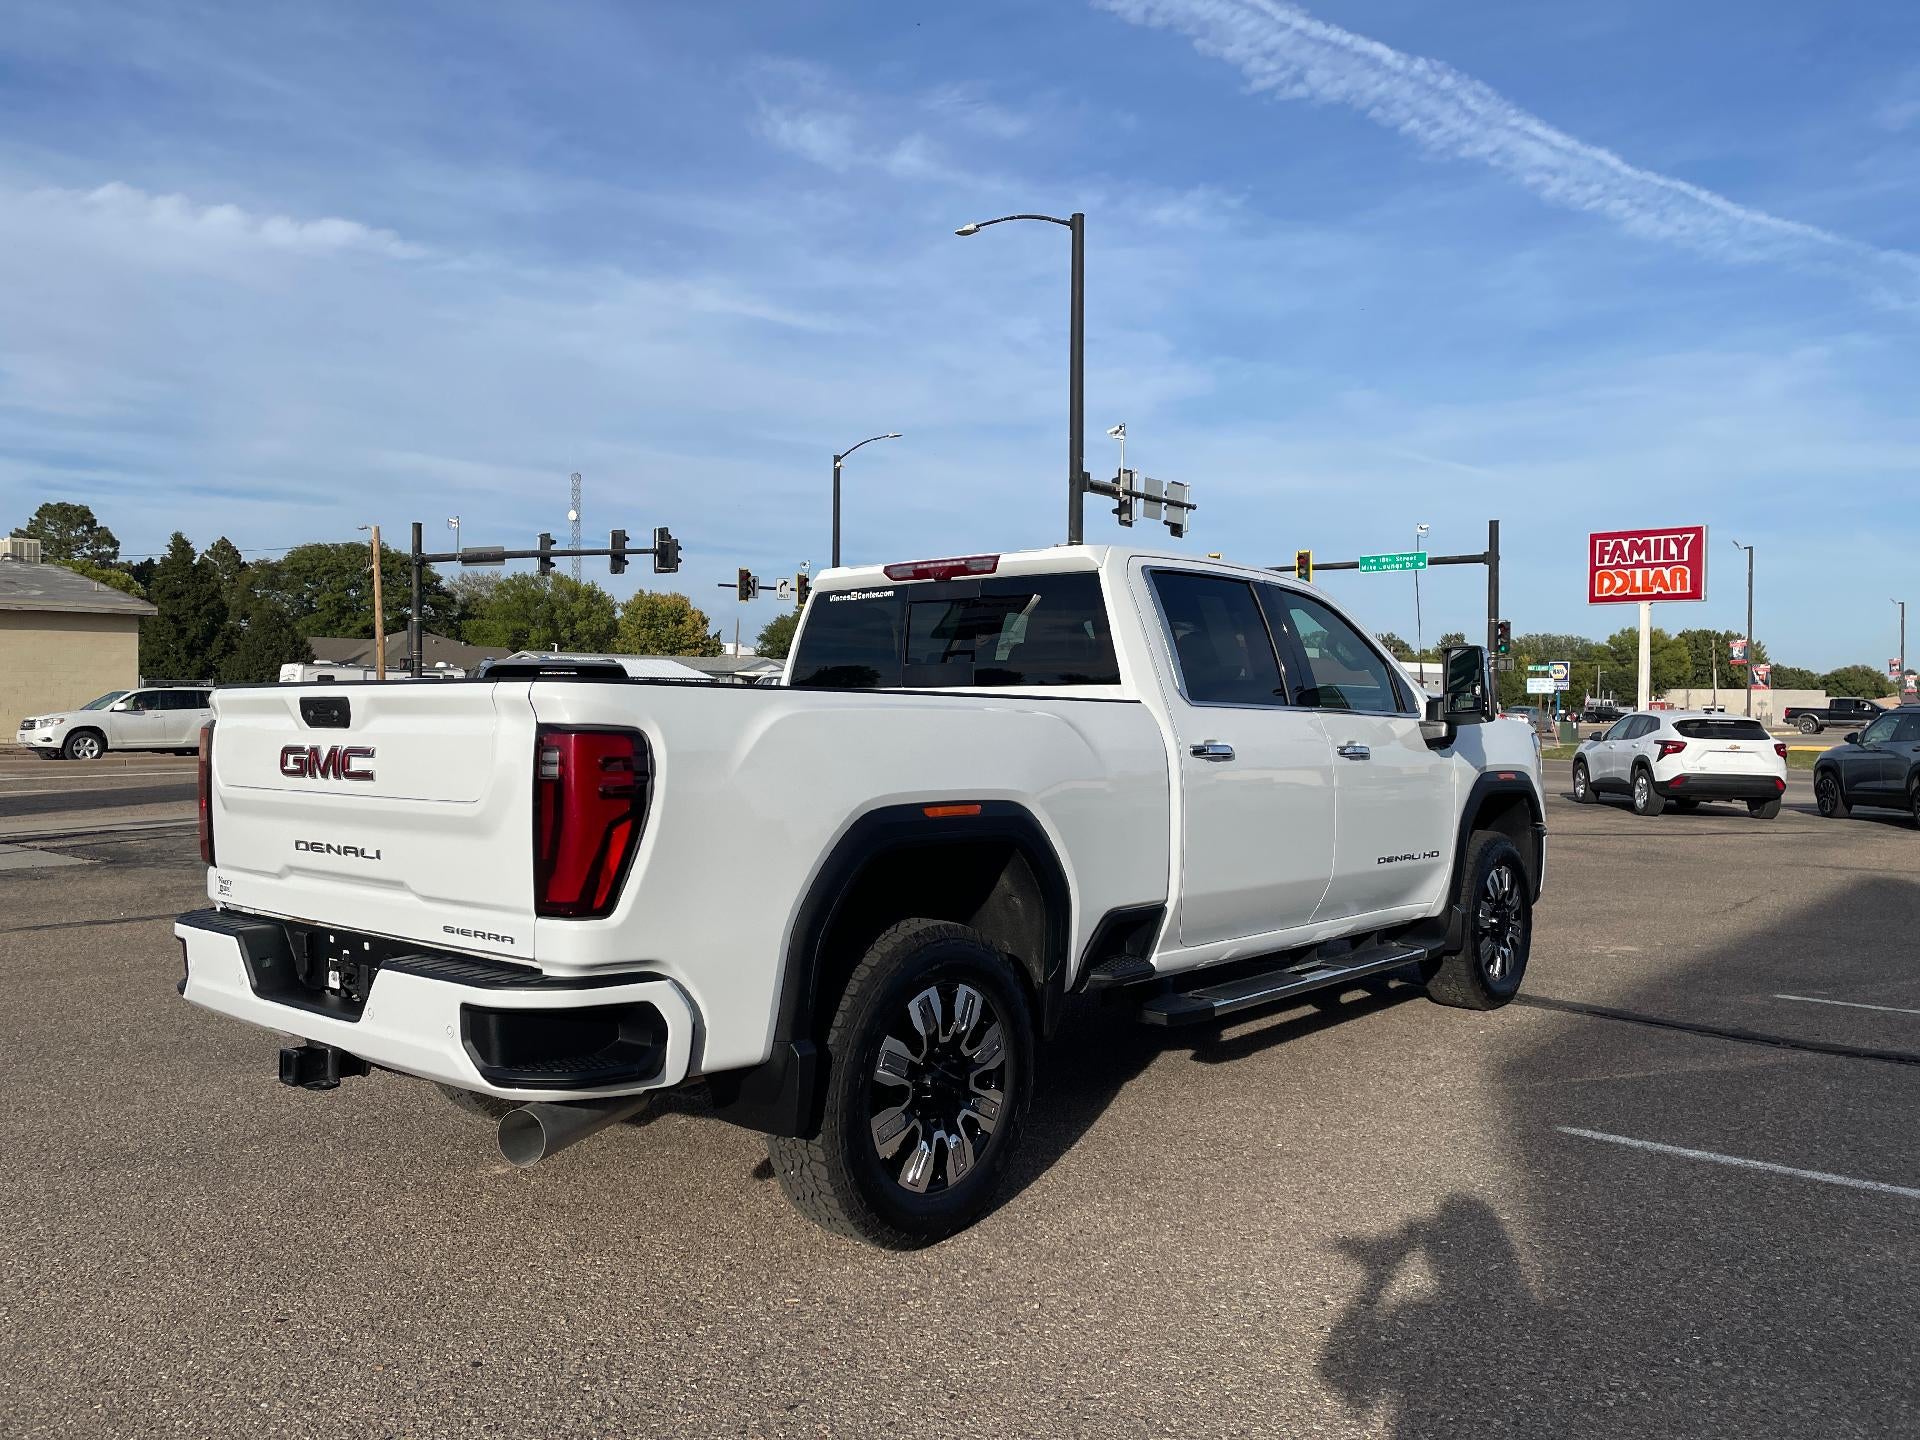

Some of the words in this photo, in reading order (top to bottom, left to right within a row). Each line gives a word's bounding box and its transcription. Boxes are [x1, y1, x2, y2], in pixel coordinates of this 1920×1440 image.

[1596, 534, 1696, 566] FAMILY
[1595, 565, 1691, 596] DOLLAR
[280, 744, 376, 781] GMC
[294, 839, 382, 860] DENALI
[1376, 853, 1421, 864] DENALI
[1422, 850, 1440, 859] HD
[442, 925, 515, 945] SIERRA
